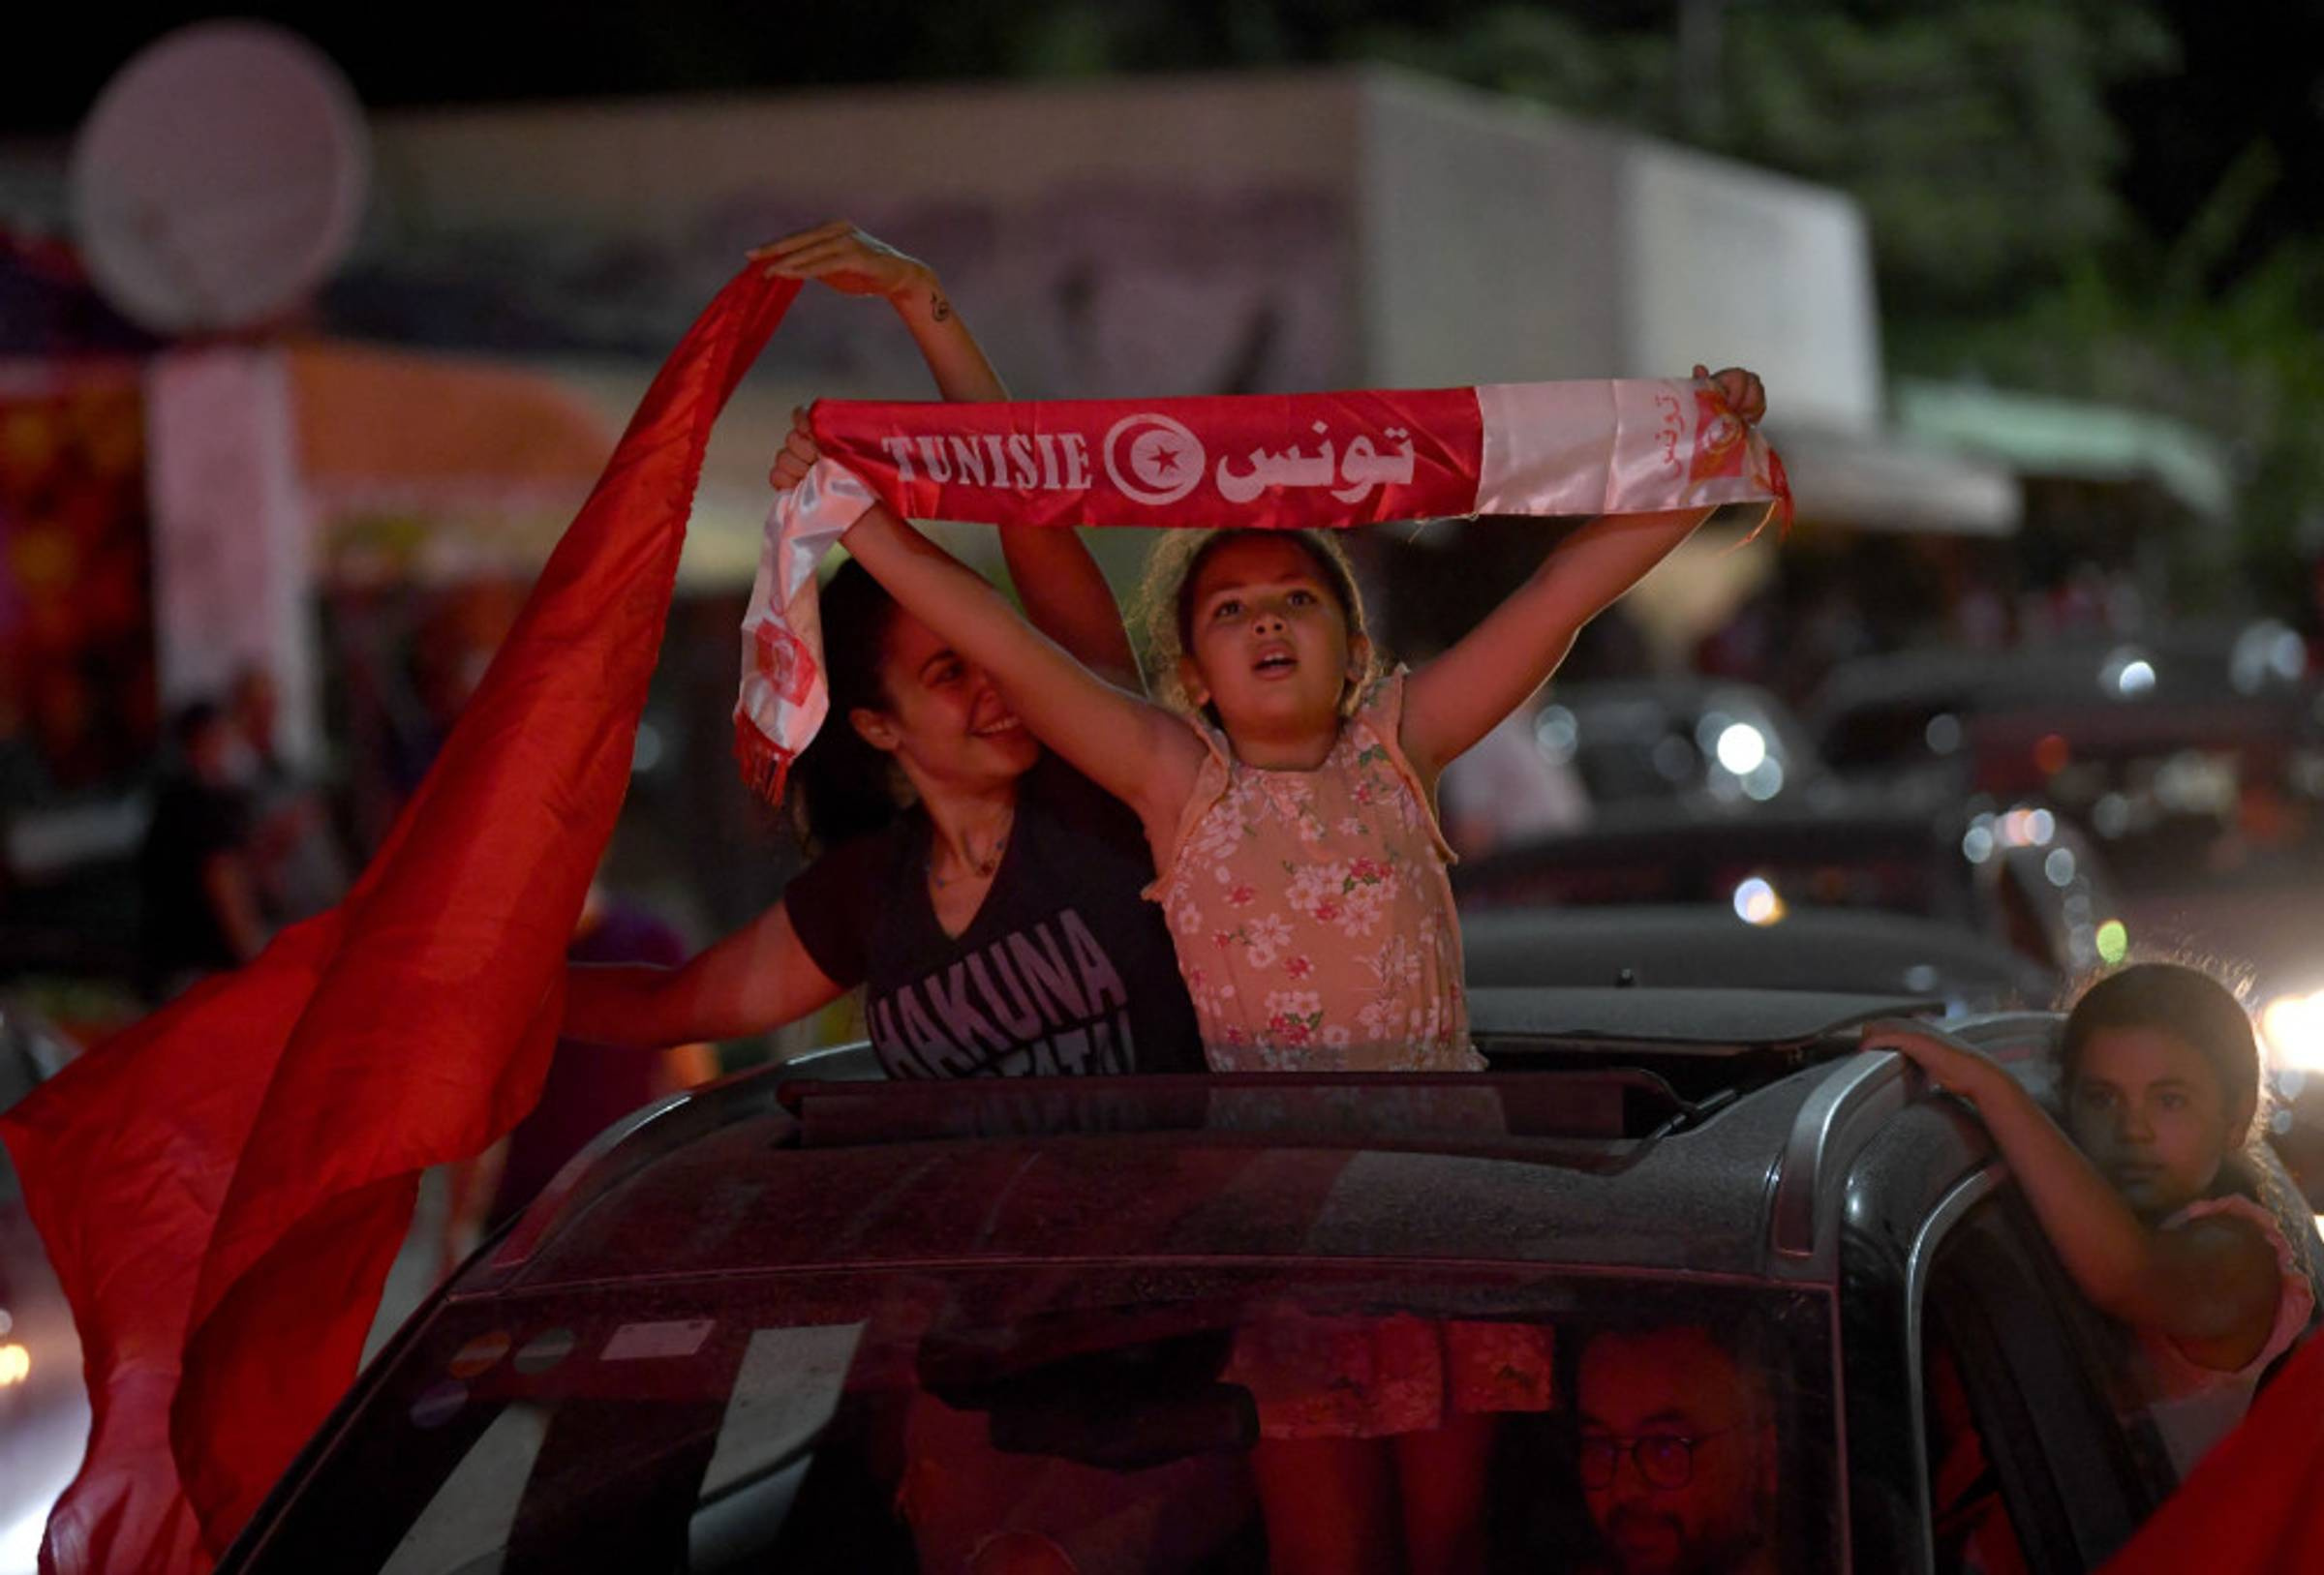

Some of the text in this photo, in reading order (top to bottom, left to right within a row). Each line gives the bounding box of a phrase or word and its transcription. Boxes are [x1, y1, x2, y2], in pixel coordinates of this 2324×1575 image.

[881, 433, 1093, 490] TUNISIE
[1215, 420, 1415, 503] تونس
[866, 907, 1129, 1079] HAKUNA
